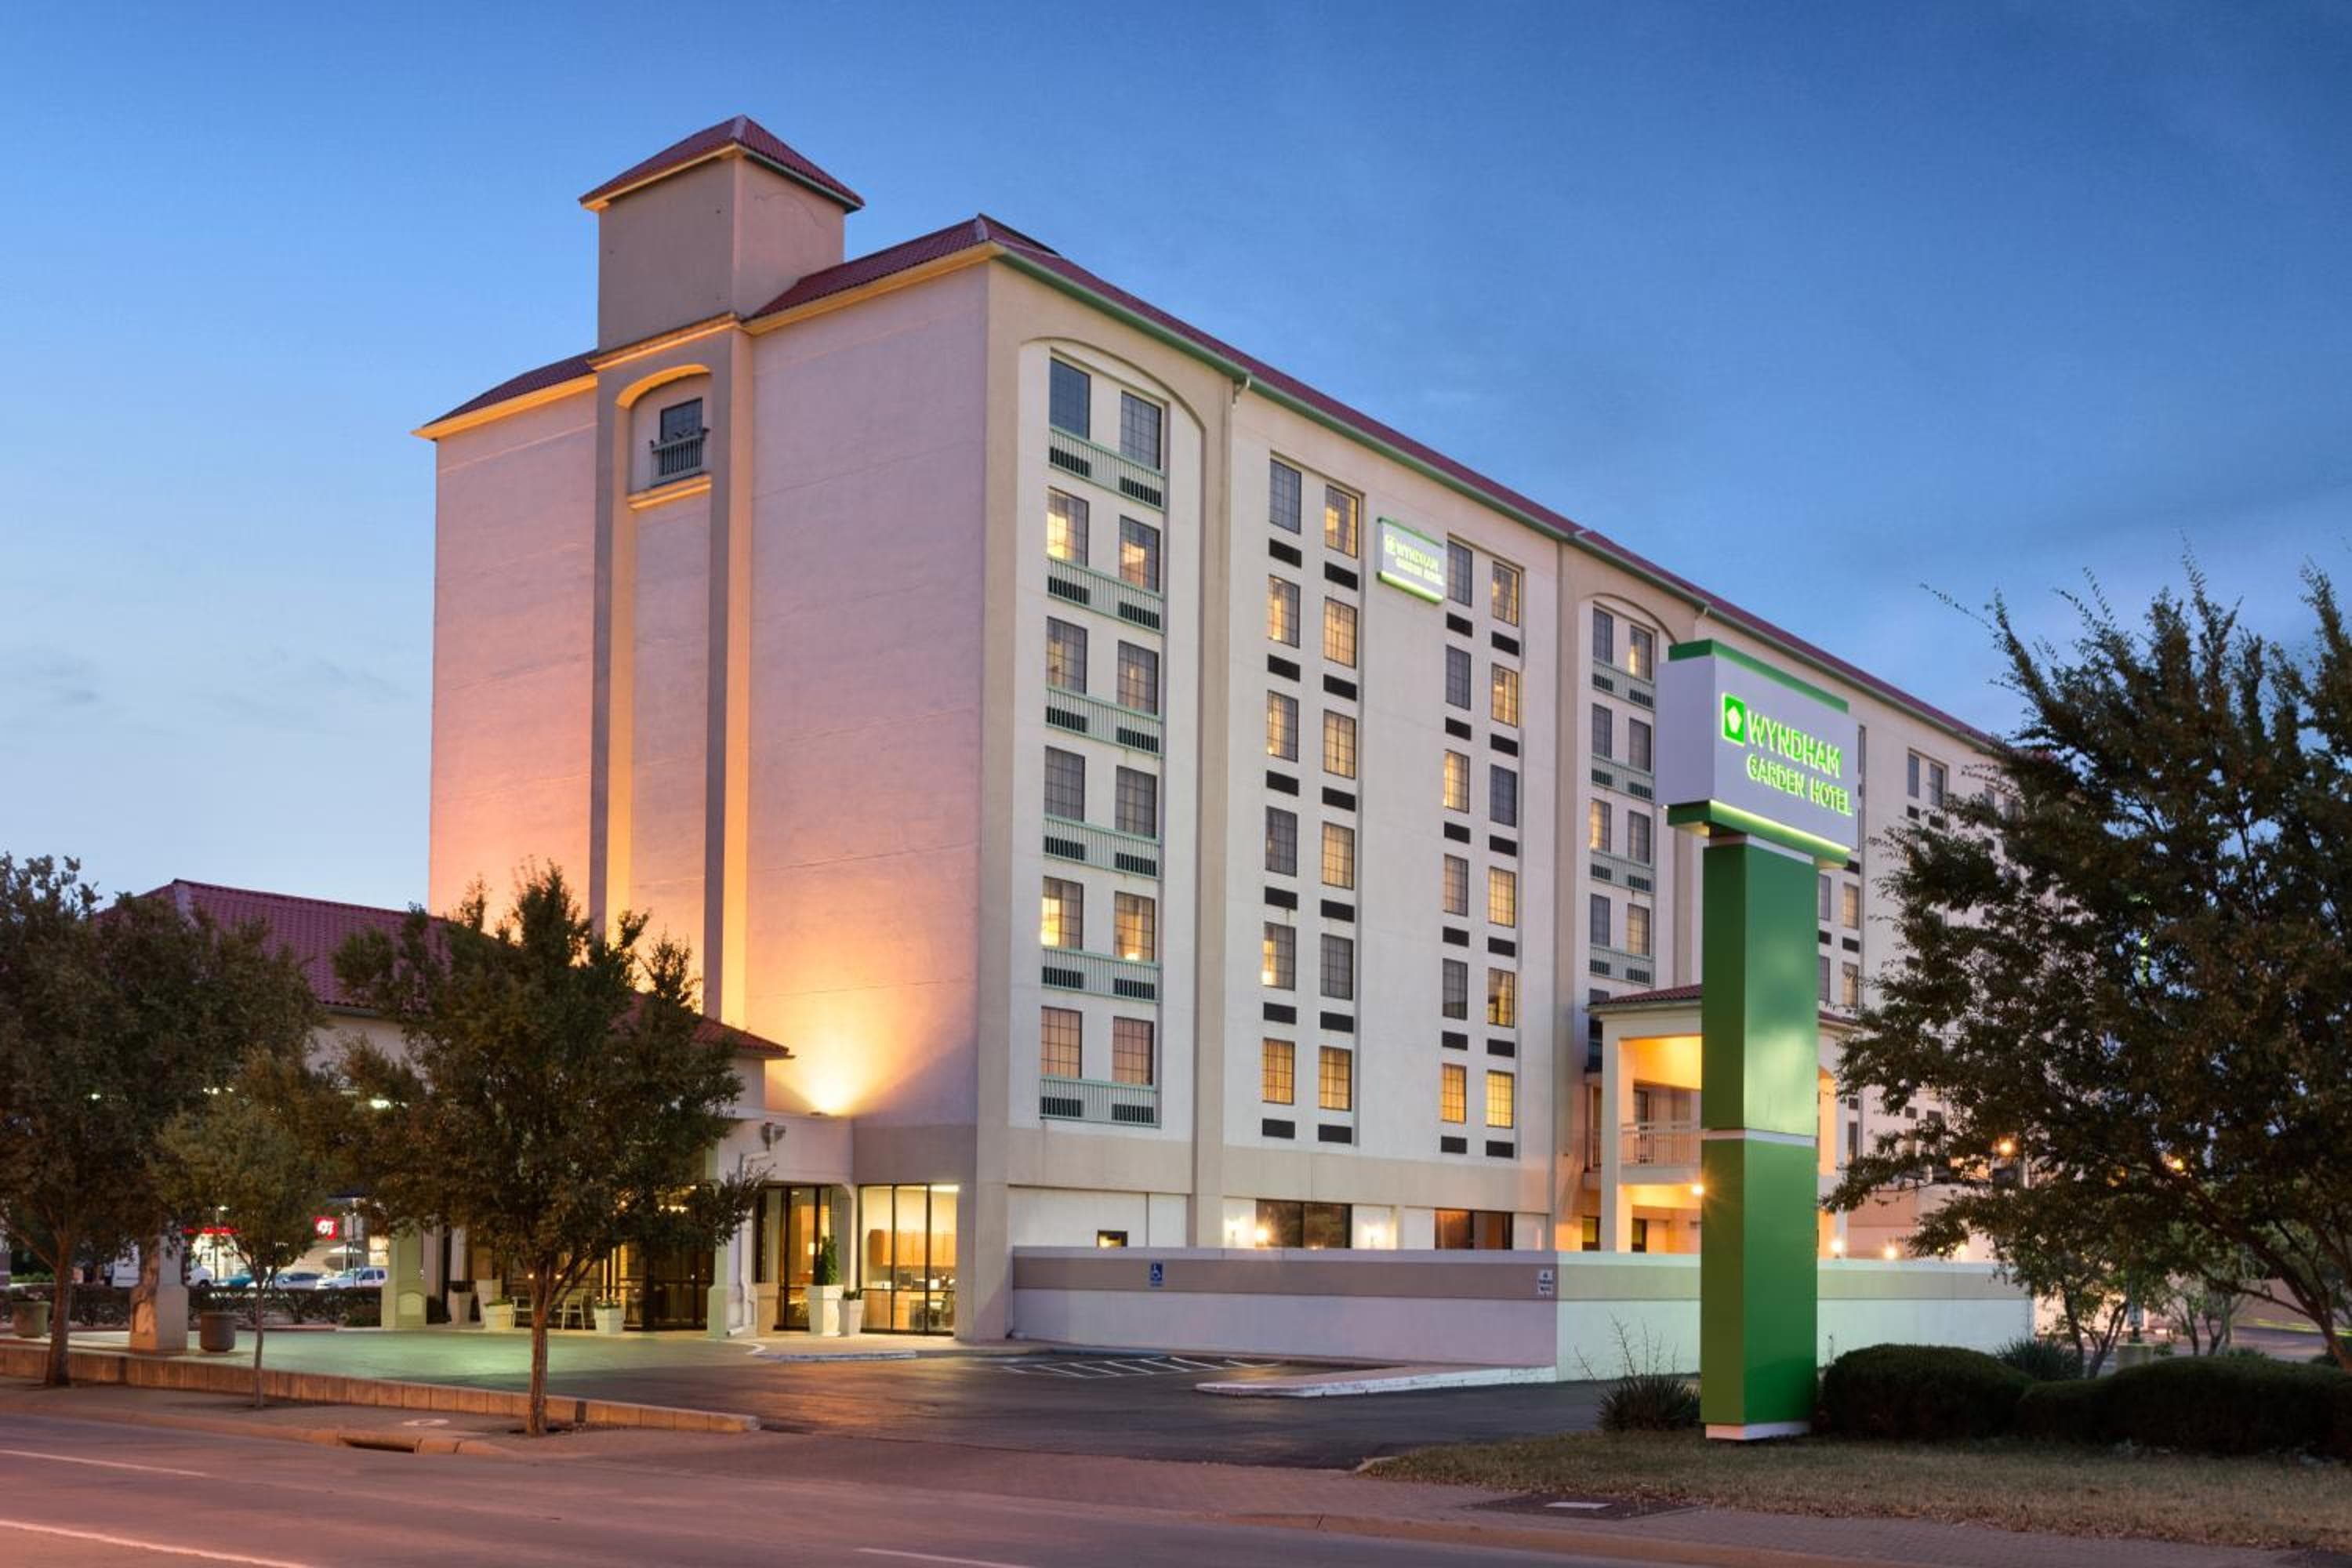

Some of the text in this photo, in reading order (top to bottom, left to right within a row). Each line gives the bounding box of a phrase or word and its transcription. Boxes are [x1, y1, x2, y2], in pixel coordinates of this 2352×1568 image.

[1748, 710, 1841, 779] WYNDHAM
[1747, 753, 1853, 816] GARDEN HOTEL
